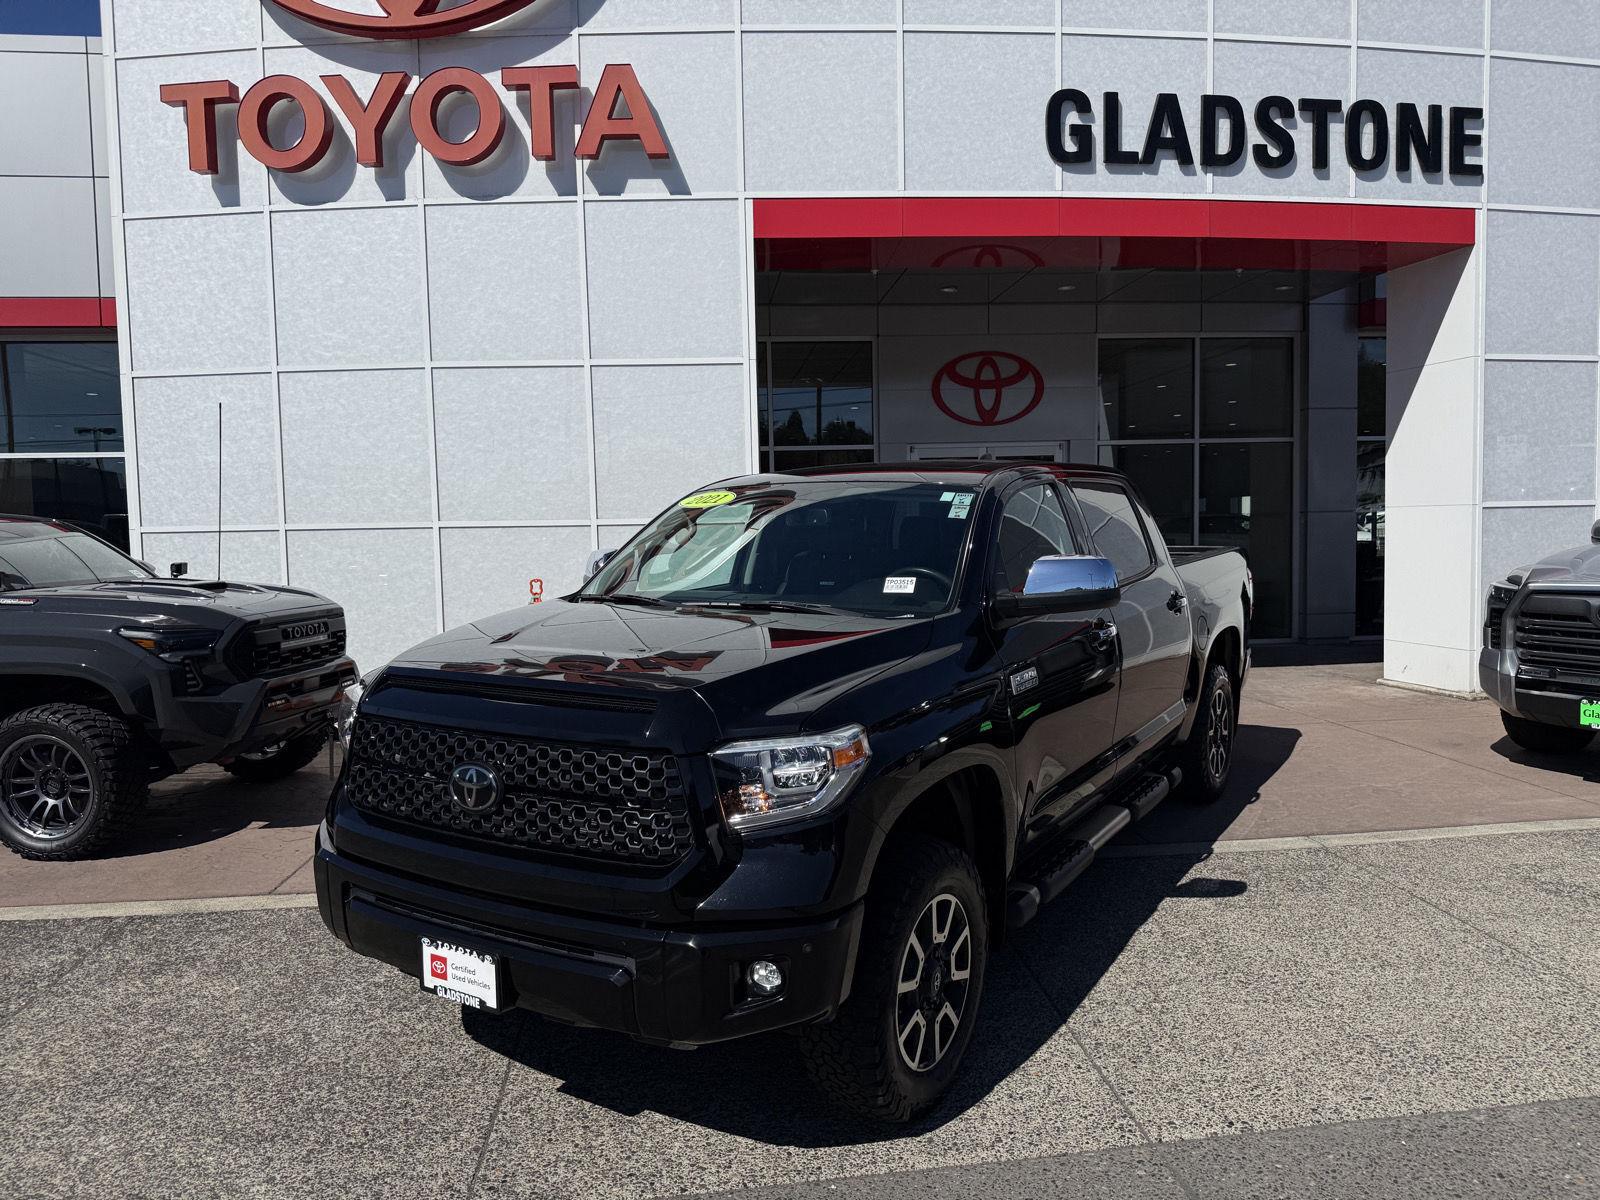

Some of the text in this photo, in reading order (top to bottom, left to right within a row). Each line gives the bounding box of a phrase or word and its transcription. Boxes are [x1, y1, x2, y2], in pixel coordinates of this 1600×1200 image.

[160, 63, 670, 176] TOYOTA
[1045, 88, 1484, 177] GLADSTONE
[287, 623, 326, 639] TOYOTA
[436, 940, 479, 959] TOYOTA
[450, 962, 476, 976] Certified
[451, 972, 491, 990] Used Vehicles
[437, 985, 481, 1010] GLADSTONE
